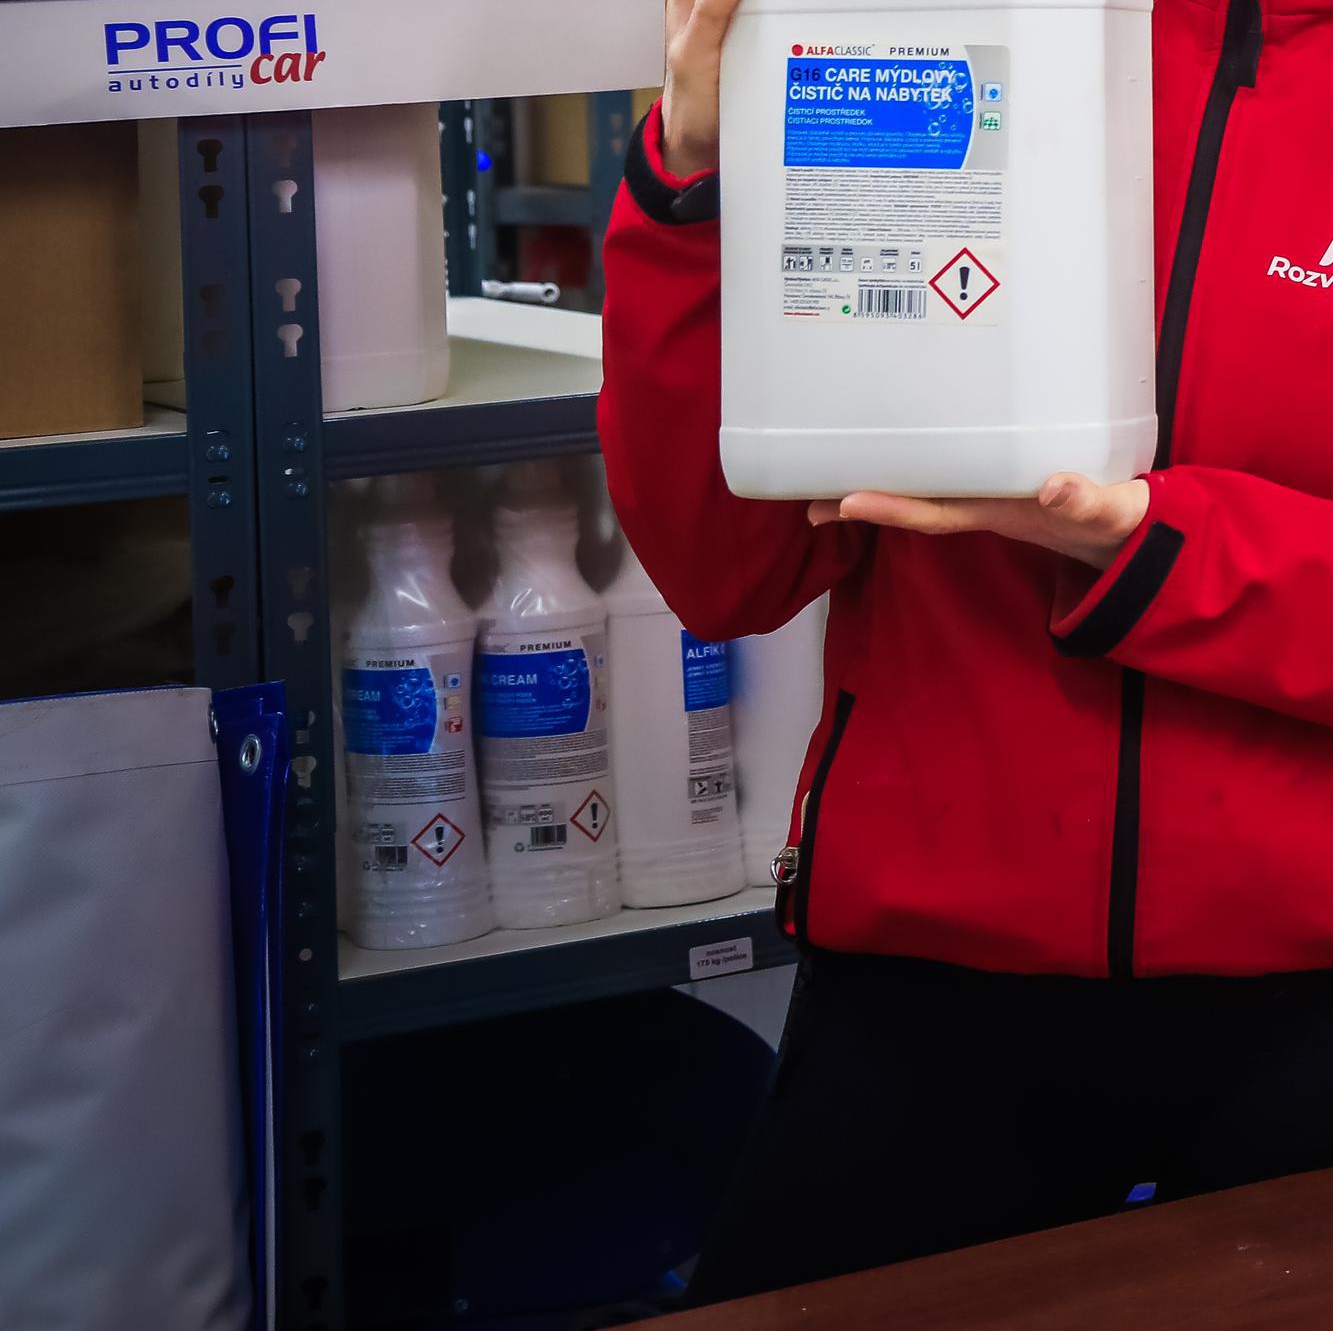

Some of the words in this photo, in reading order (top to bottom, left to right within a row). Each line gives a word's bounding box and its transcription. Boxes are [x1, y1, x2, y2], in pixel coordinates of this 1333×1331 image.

[104, 14, 318, 66] PROFI
[807, 45, 871, 56] ALFACLASSIC
[889, 47, 950, 56] PREMIUM
[108, 71, 244, 93] autodíly
[250, 51, 326, 84] car
[790, 67, 821, 82] G16
[825, 68, 871, 82] CARE
[875, 64, 956, 84] MÝDLOVÝ
[789, 82, 845, 101] ČISTIČ
[848, 88, 872, 101] NA
[876, 84, 953, 102] NÁBYTEK
[520, 640, 572, 651] PREMIUM
[366, 659, 415, 668] PREMIUM
[491, 673, 538, 686] CREAM
